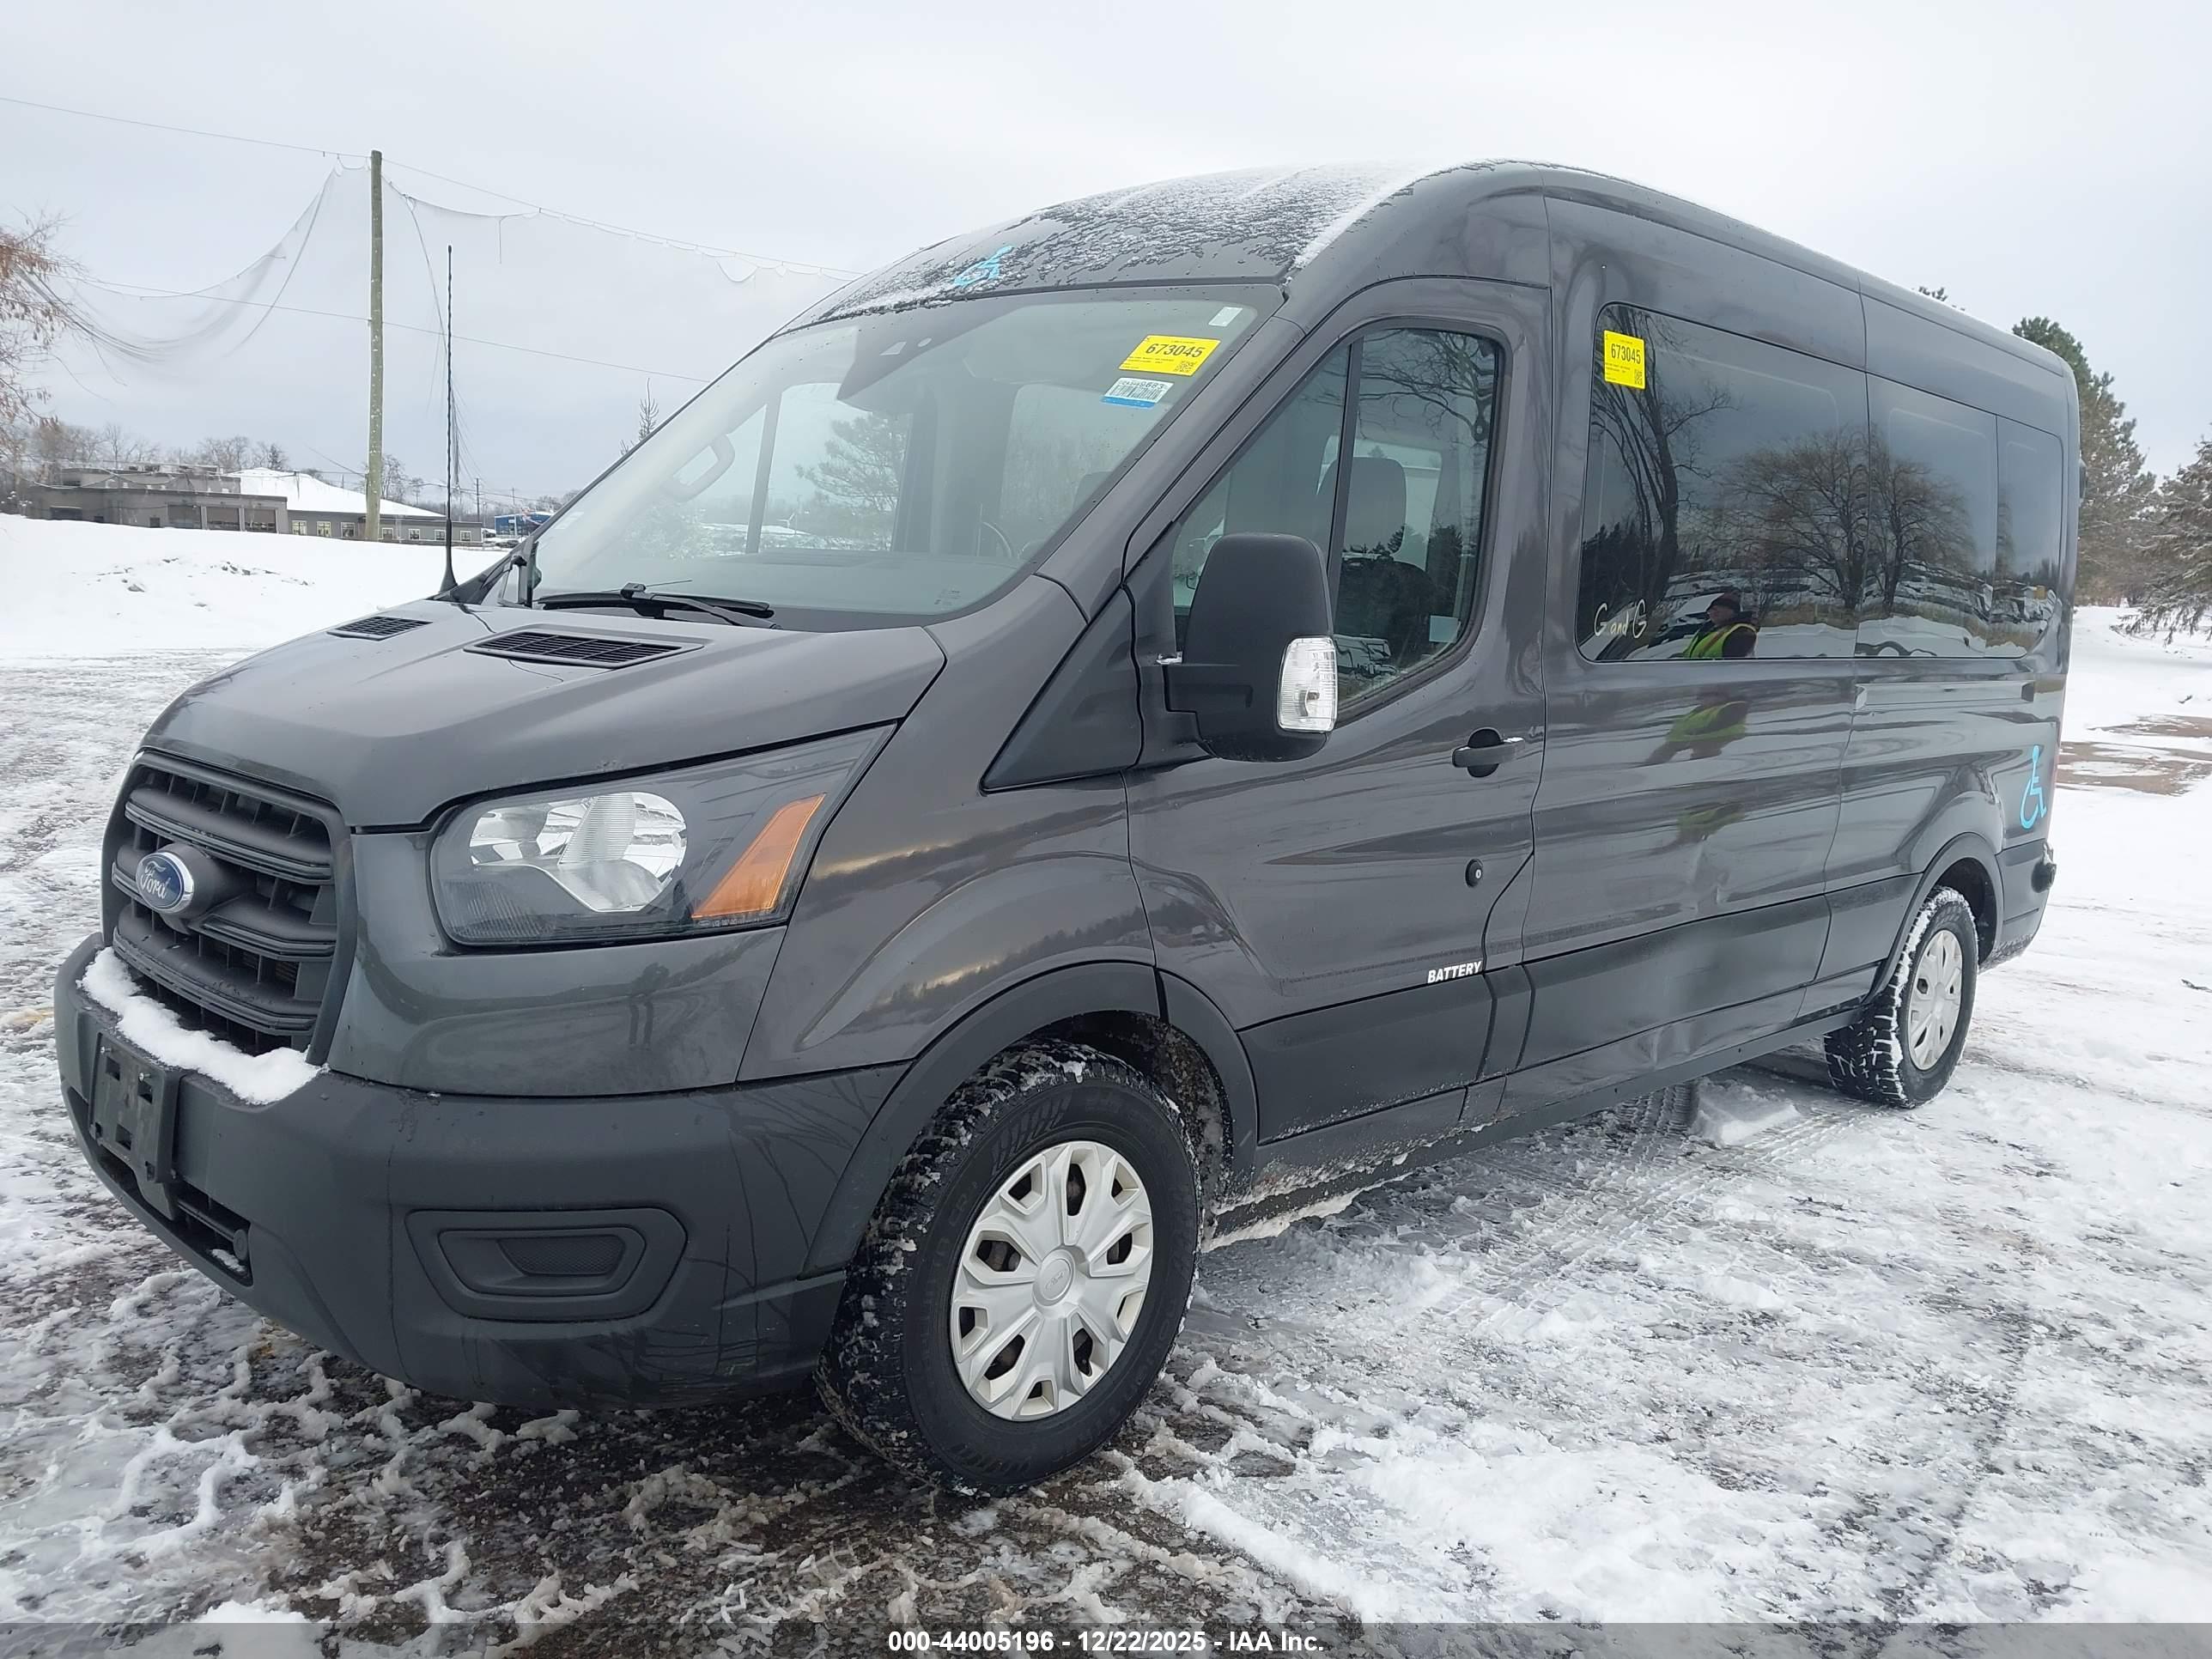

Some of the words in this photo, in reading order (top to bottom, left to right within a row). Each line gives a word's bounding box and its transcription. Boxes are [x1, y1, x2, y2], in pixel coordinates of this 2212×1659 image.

[1146, 343, 1206, 358] 673045
[1611, 343, 1641, 364] 673045
[1594, 603, 1607, 636] G
[1610, 611, 1629, 636] and
[1632, 599, 1647, 638] G
[140, 860, 171, 899] Ford
[1427, 961, 1482, 984] BATTERY
